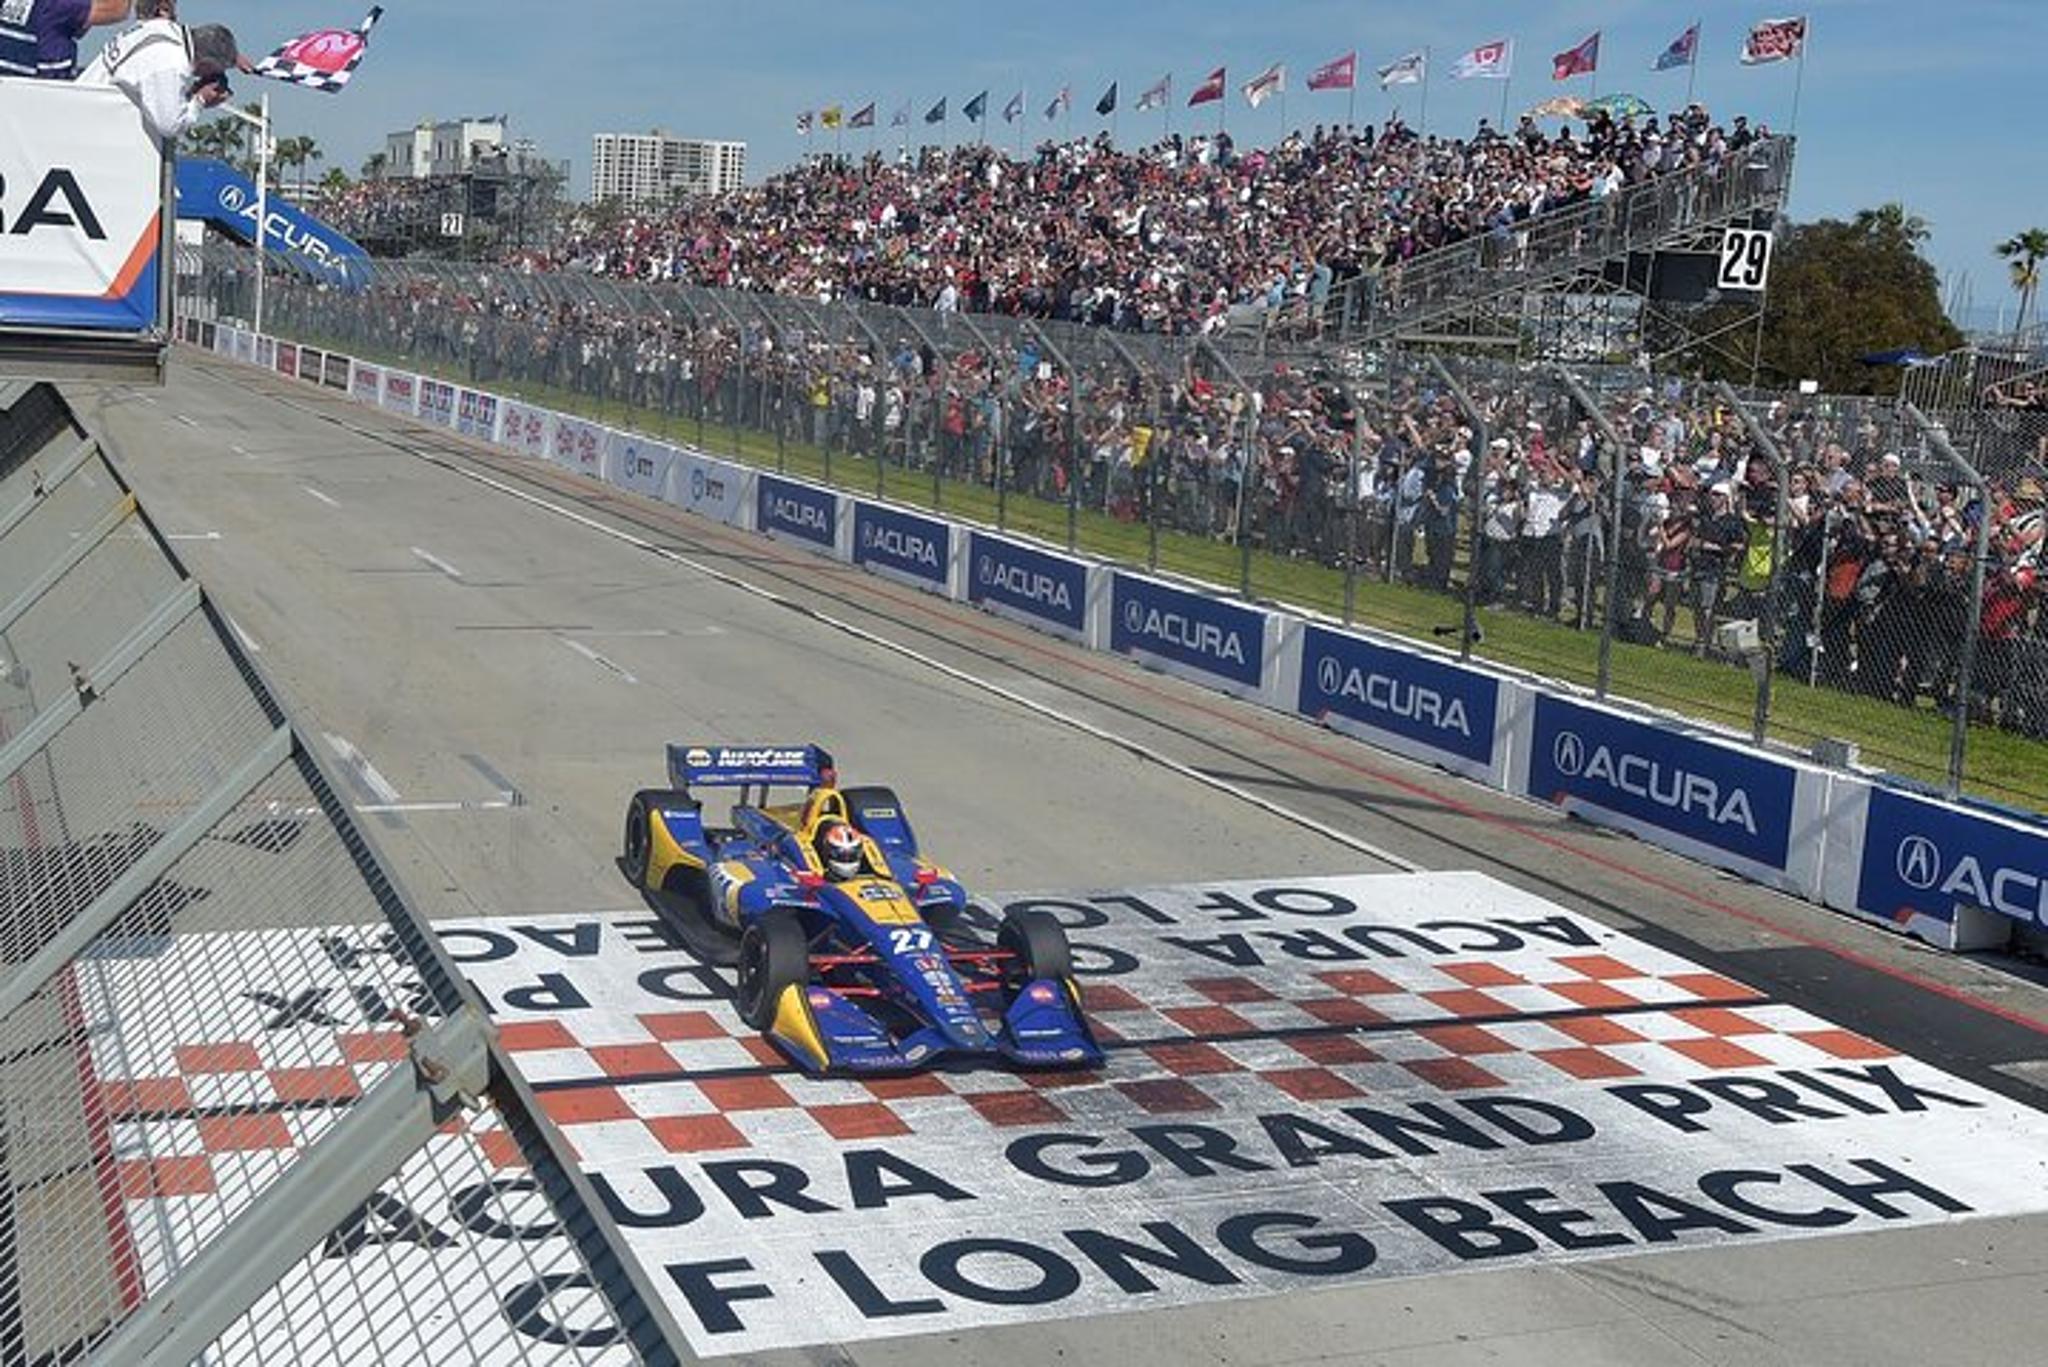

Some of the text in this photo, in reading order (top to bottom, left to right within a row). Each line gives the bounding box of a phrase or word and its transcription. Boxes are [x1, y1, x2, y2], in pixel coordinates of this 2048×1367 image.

[0, 168, 107, 239] A
[239, 202, 348, 278] ACURA
[1722, 229, 1768, 286] 29
[774, 499, 829, 534] ACURA
[873, 528, 939, 568] ACURA
[993, 562, 1072, 611] ACURA
[1141, 607, 1246, 665] ACURA
[1341, 666, 1471, 738] ACURA
[1584, 745, 1758, 836] ACURA
[1195, 887, 1358, 921] OF
[1939, 855, 2048, 926] AC
[889, 927, 933, 955] 27
[1157, 915, 1601, 967] ACURA
[1004, 1095, 1597, 1189] GRAND
[1602, 1064, 1987, 1134] PRIX
[812, 1209, 1378, 1321] LONG
[1381, 1157, 1977, 1262] BEACH
